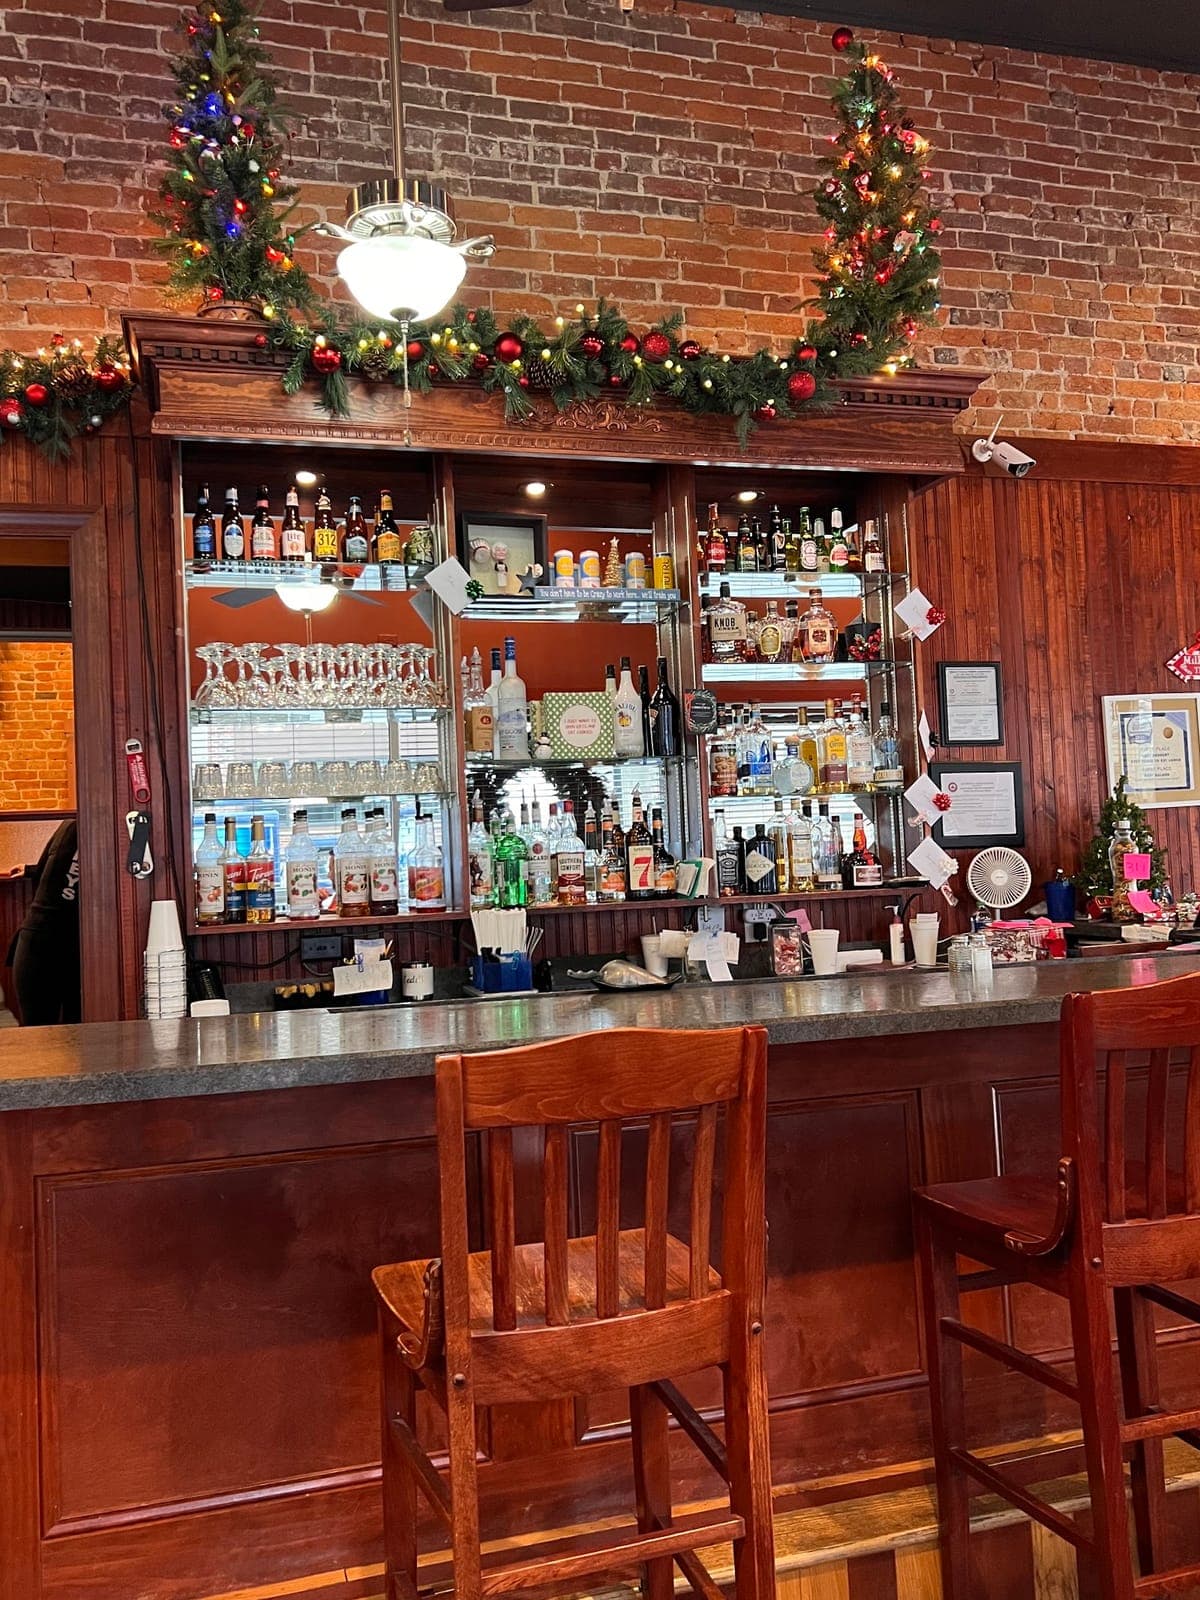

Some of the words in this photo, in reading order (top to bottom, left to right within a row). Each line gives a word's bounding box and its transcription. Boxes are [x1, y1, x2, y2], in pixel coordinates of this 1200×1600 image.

[318, 533, 336, 546] 312
[563, 589, 576, 597] have
[714, 617, 736, 627] KNOB
[633, 856, 652, 887] 7
